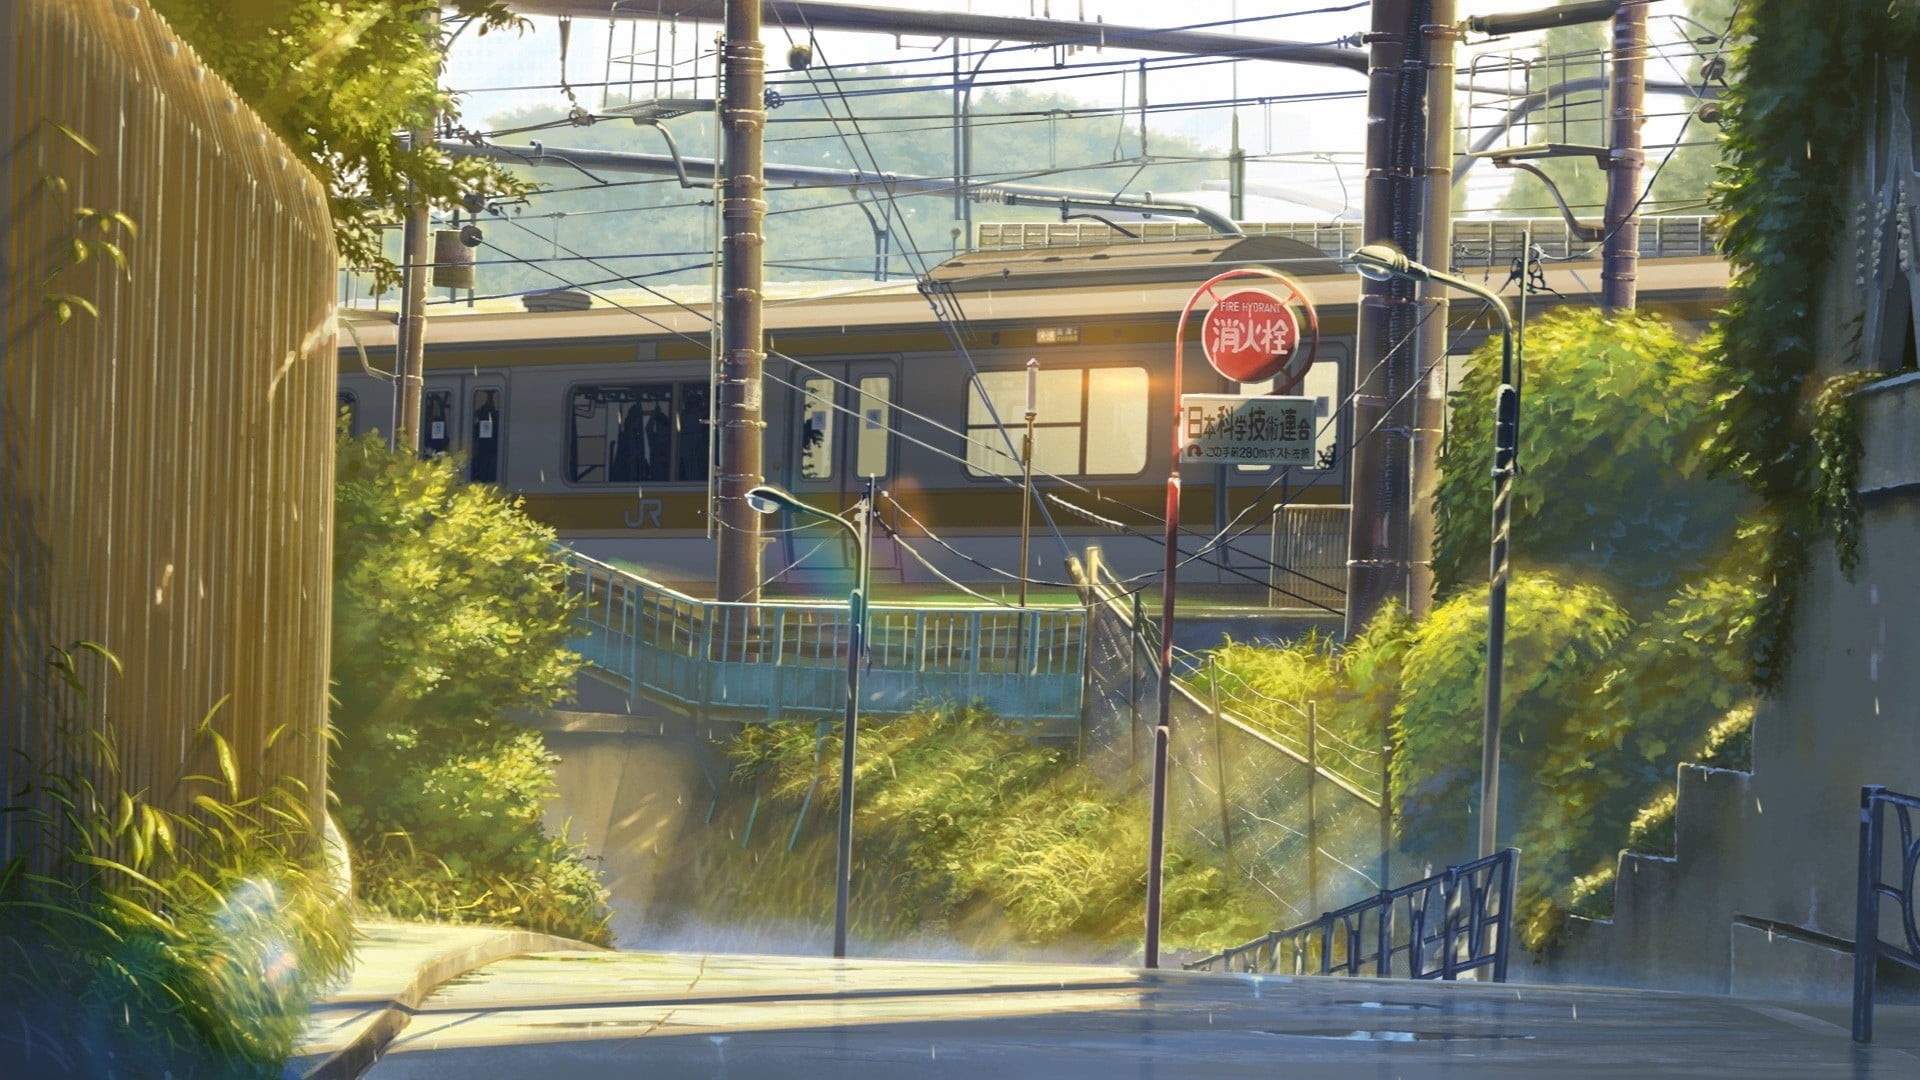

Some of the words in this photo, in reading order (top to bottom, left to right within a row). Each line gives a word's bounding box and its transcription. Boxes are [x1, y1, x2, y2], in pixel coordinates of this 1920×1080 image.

[1220, 301, 1240, 312] FIRE
[1242, 302, 1281, 313] HYDRANT
[1213, 318, 1289, 355] 消火栓
[624, 498, 663, 529] JR
